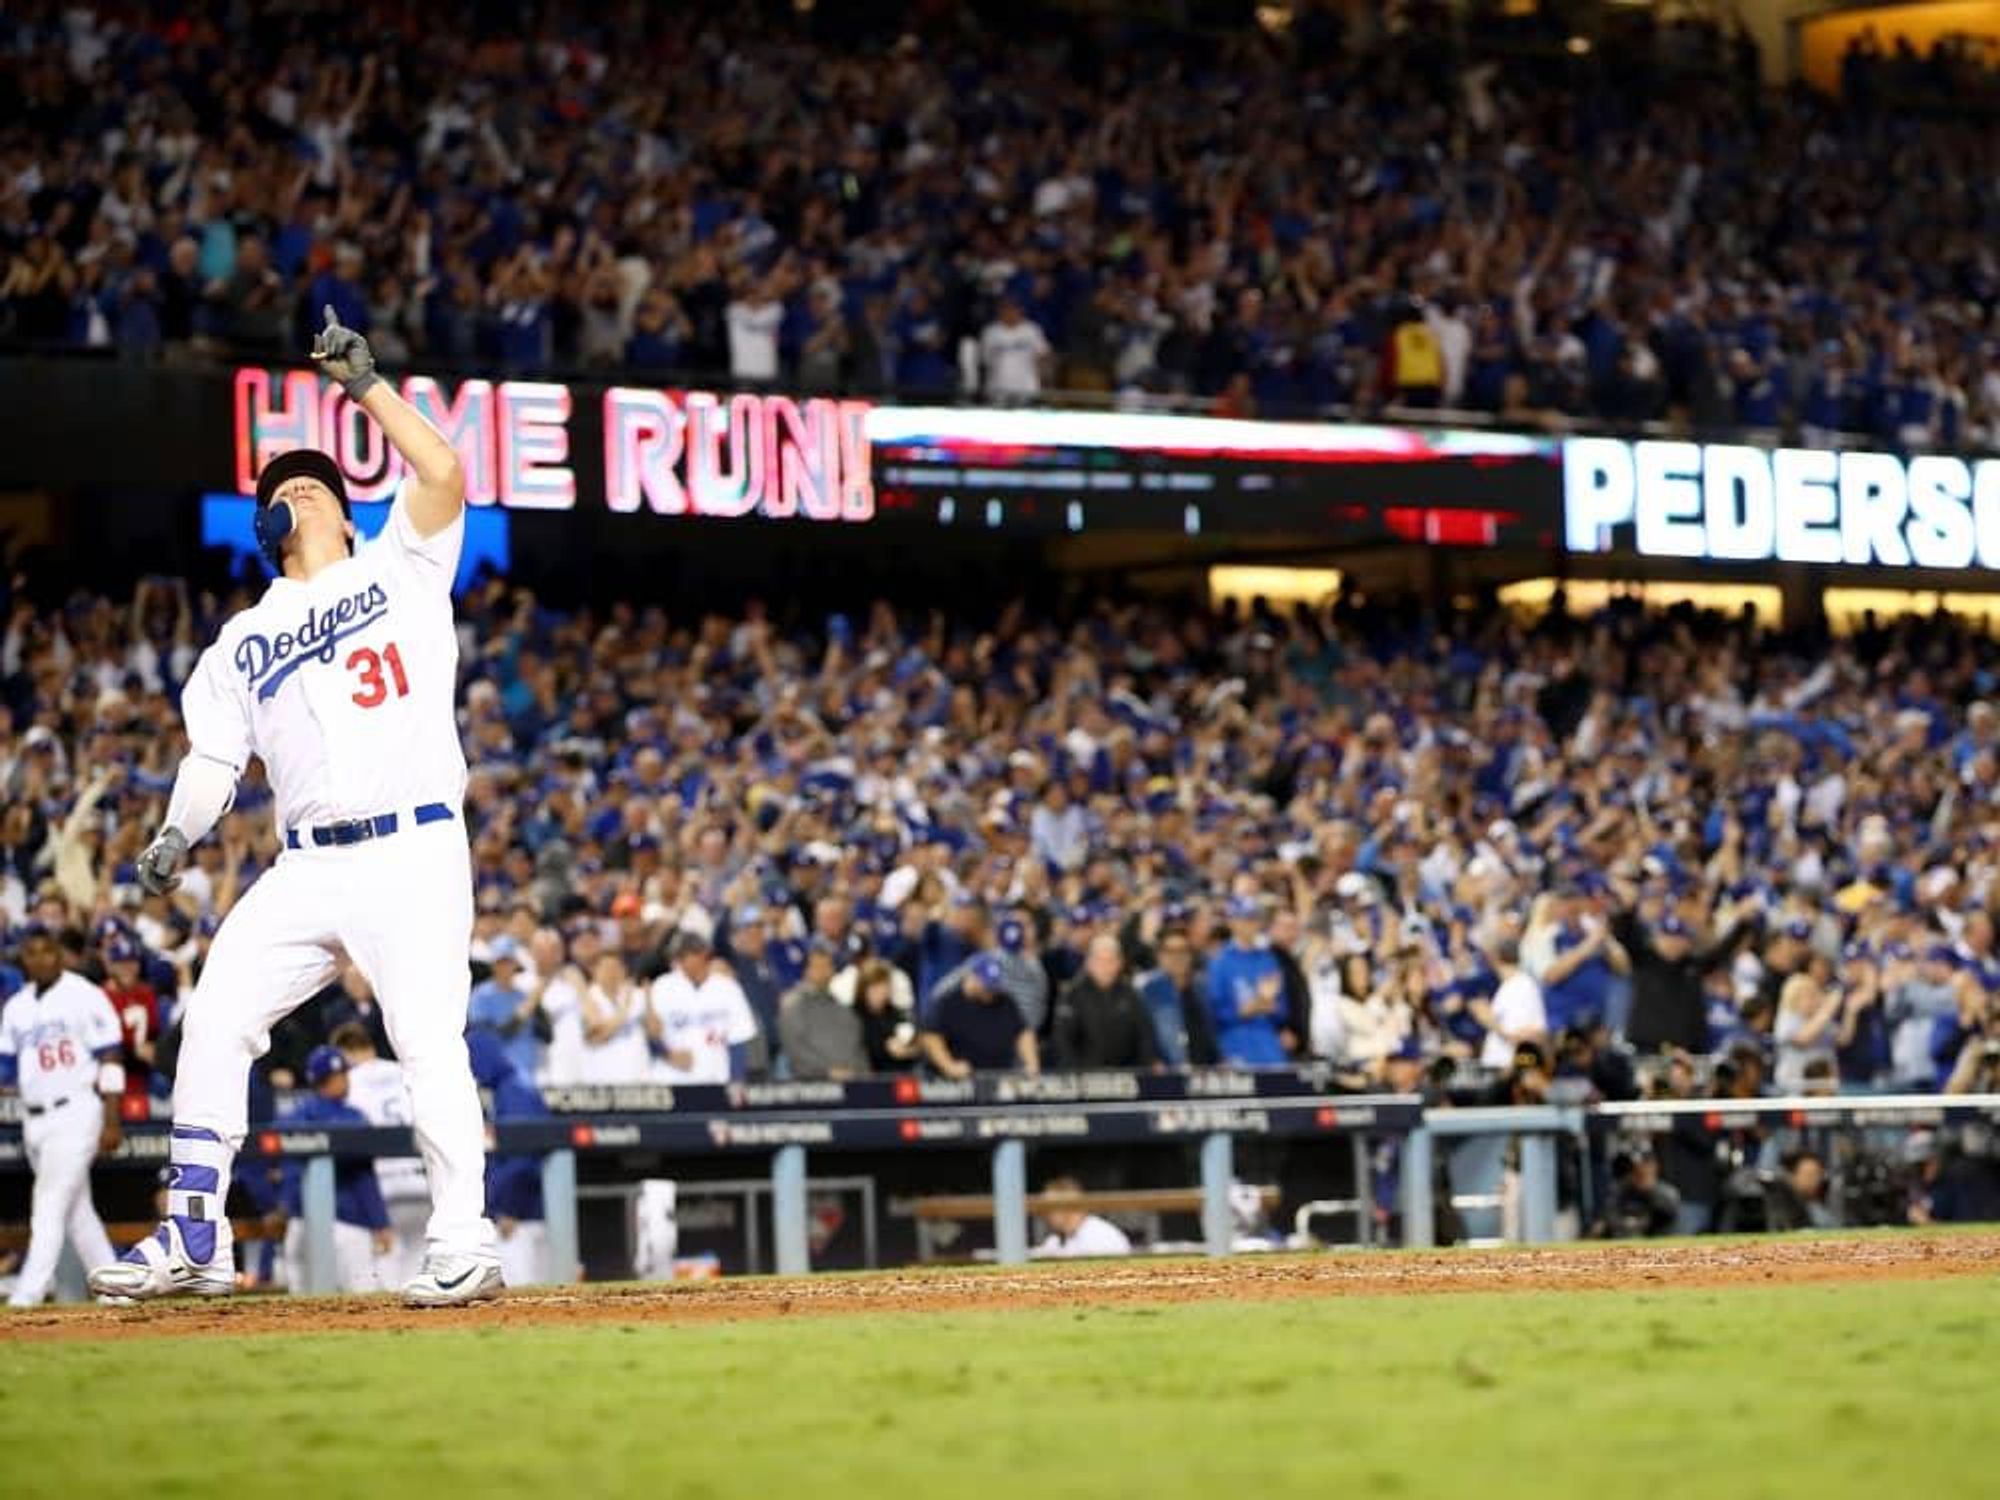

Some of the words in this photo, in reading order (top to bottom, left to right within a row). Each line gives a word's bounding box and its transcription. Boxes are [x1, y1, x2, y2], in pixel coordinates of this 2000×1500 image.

[603, 386, 875, 521] RUN!
[235, 582, 388, 692] Dodgers
[345, 641, 410, 709] 31
[38, 1039, 76, 1072] 66
